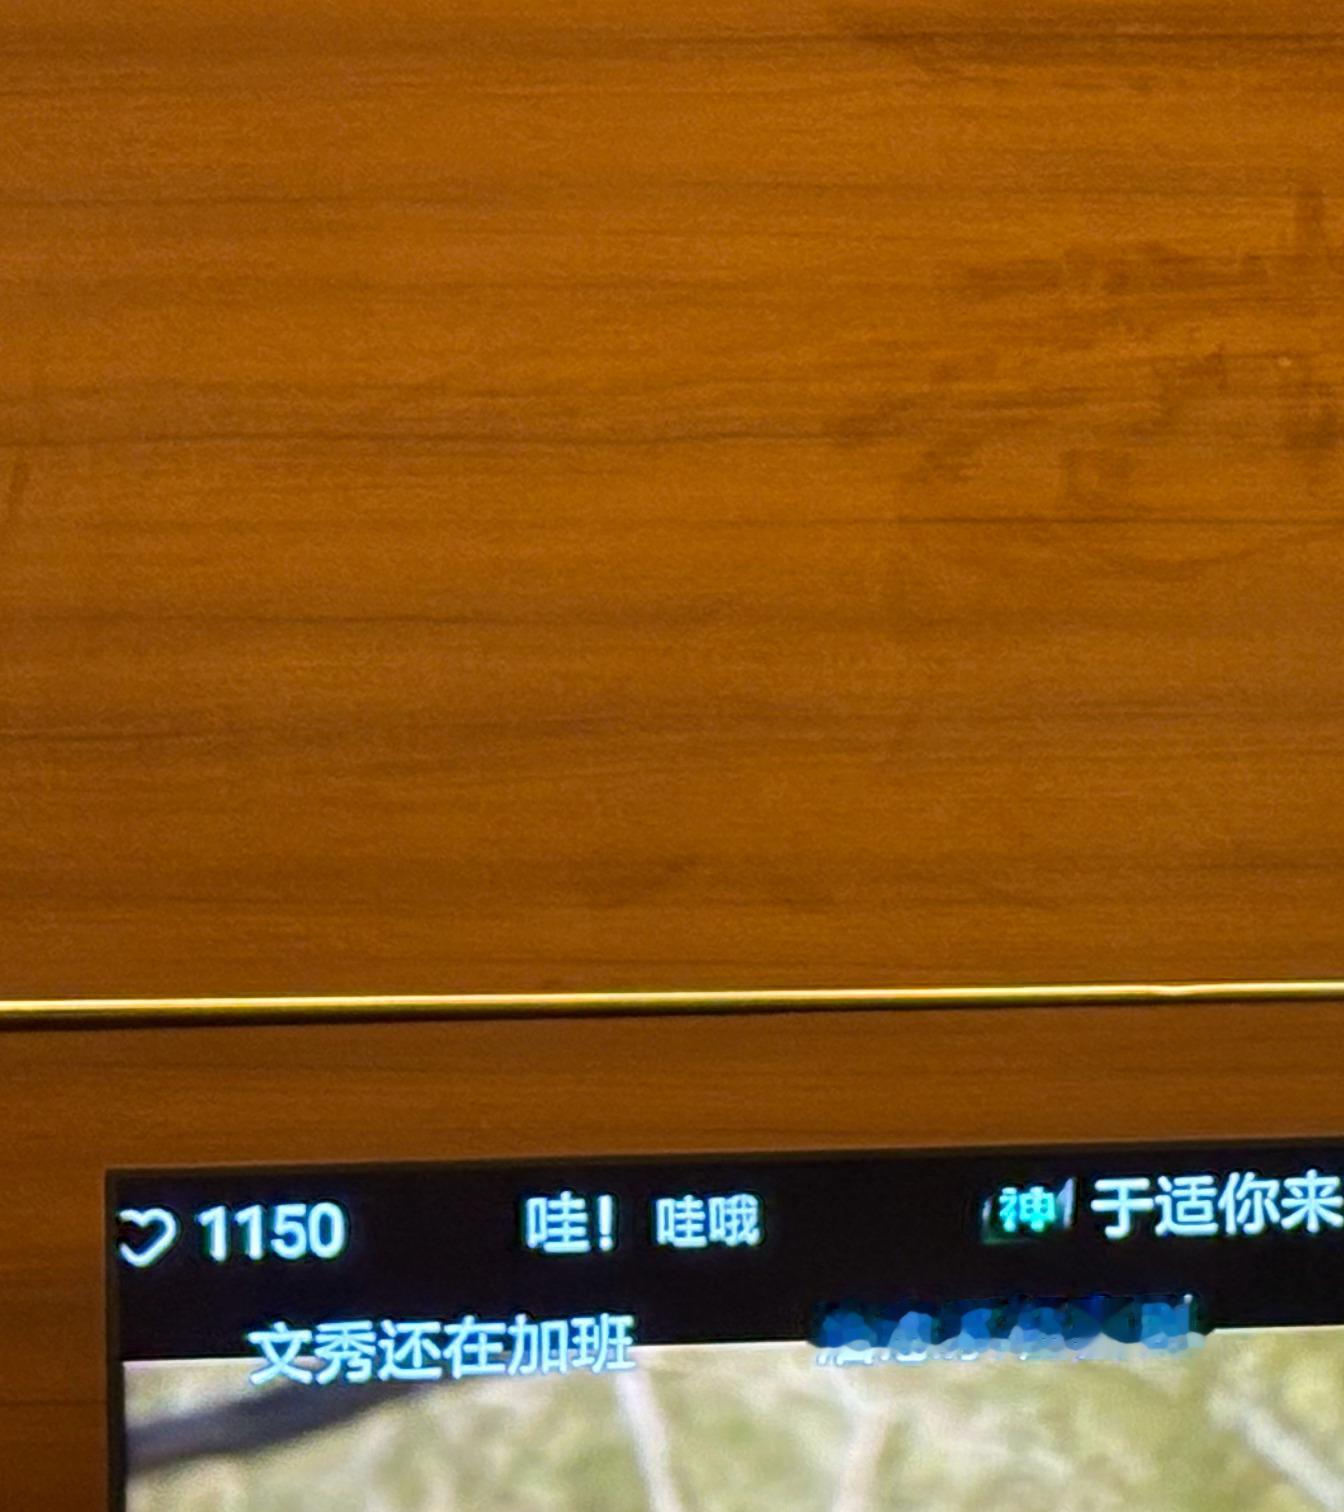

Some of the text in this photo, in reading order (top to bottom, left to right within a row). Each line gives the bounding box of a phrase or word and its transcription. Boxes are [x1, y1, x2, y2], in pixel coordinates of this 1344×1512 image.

[197, 1203, 345, 1261] 1150
[655, 1194, 760, 1248] 哇哦
[247, 1314, 636, 1389] 文秀还在加班
